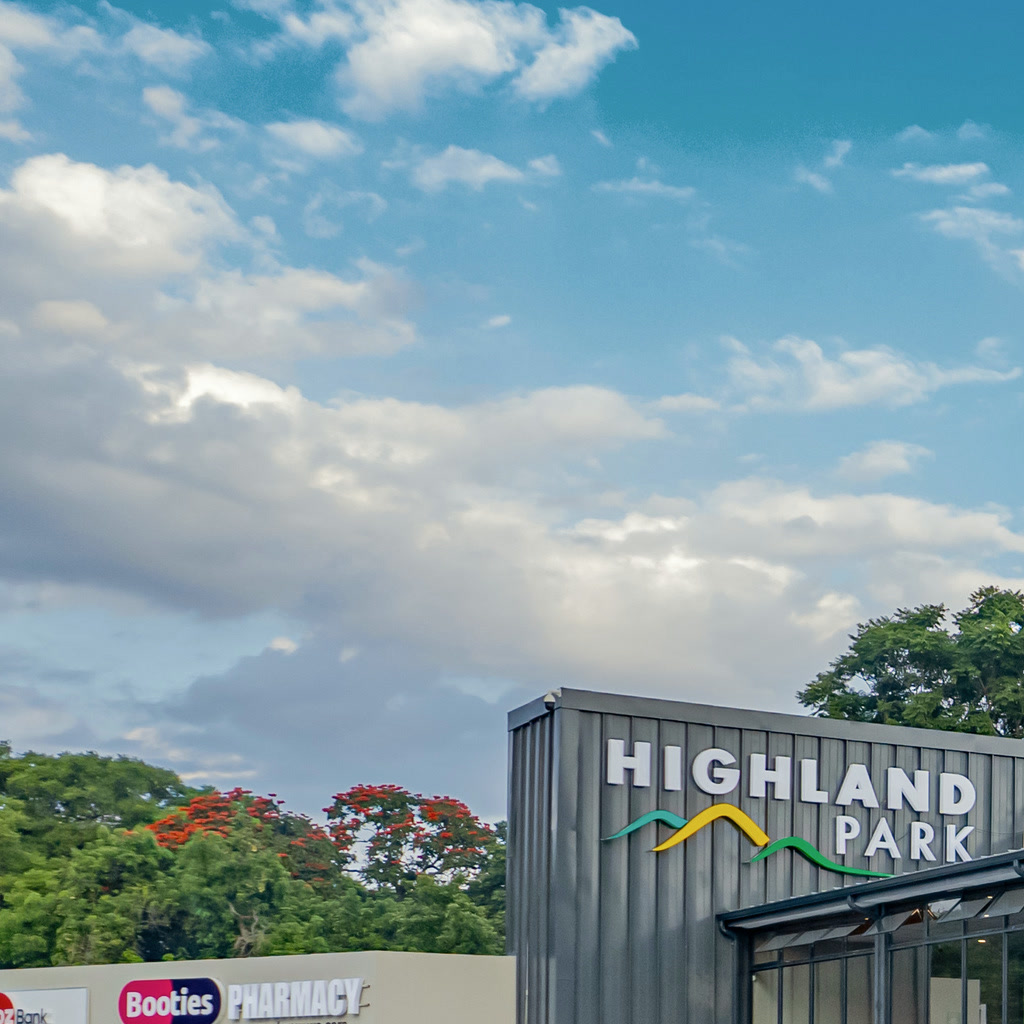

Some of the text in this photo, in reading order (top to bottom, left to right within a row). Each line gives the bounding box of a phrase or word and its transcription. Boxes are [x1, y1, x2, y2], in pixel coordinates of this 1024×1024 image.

[607, 738, 977, 816] HIGHLAND
[835, 815, 975, 863] PARK
[17, 1008, 48, 1024] Bank
[126, 977, 365, 1020] Booties PHARMACY
